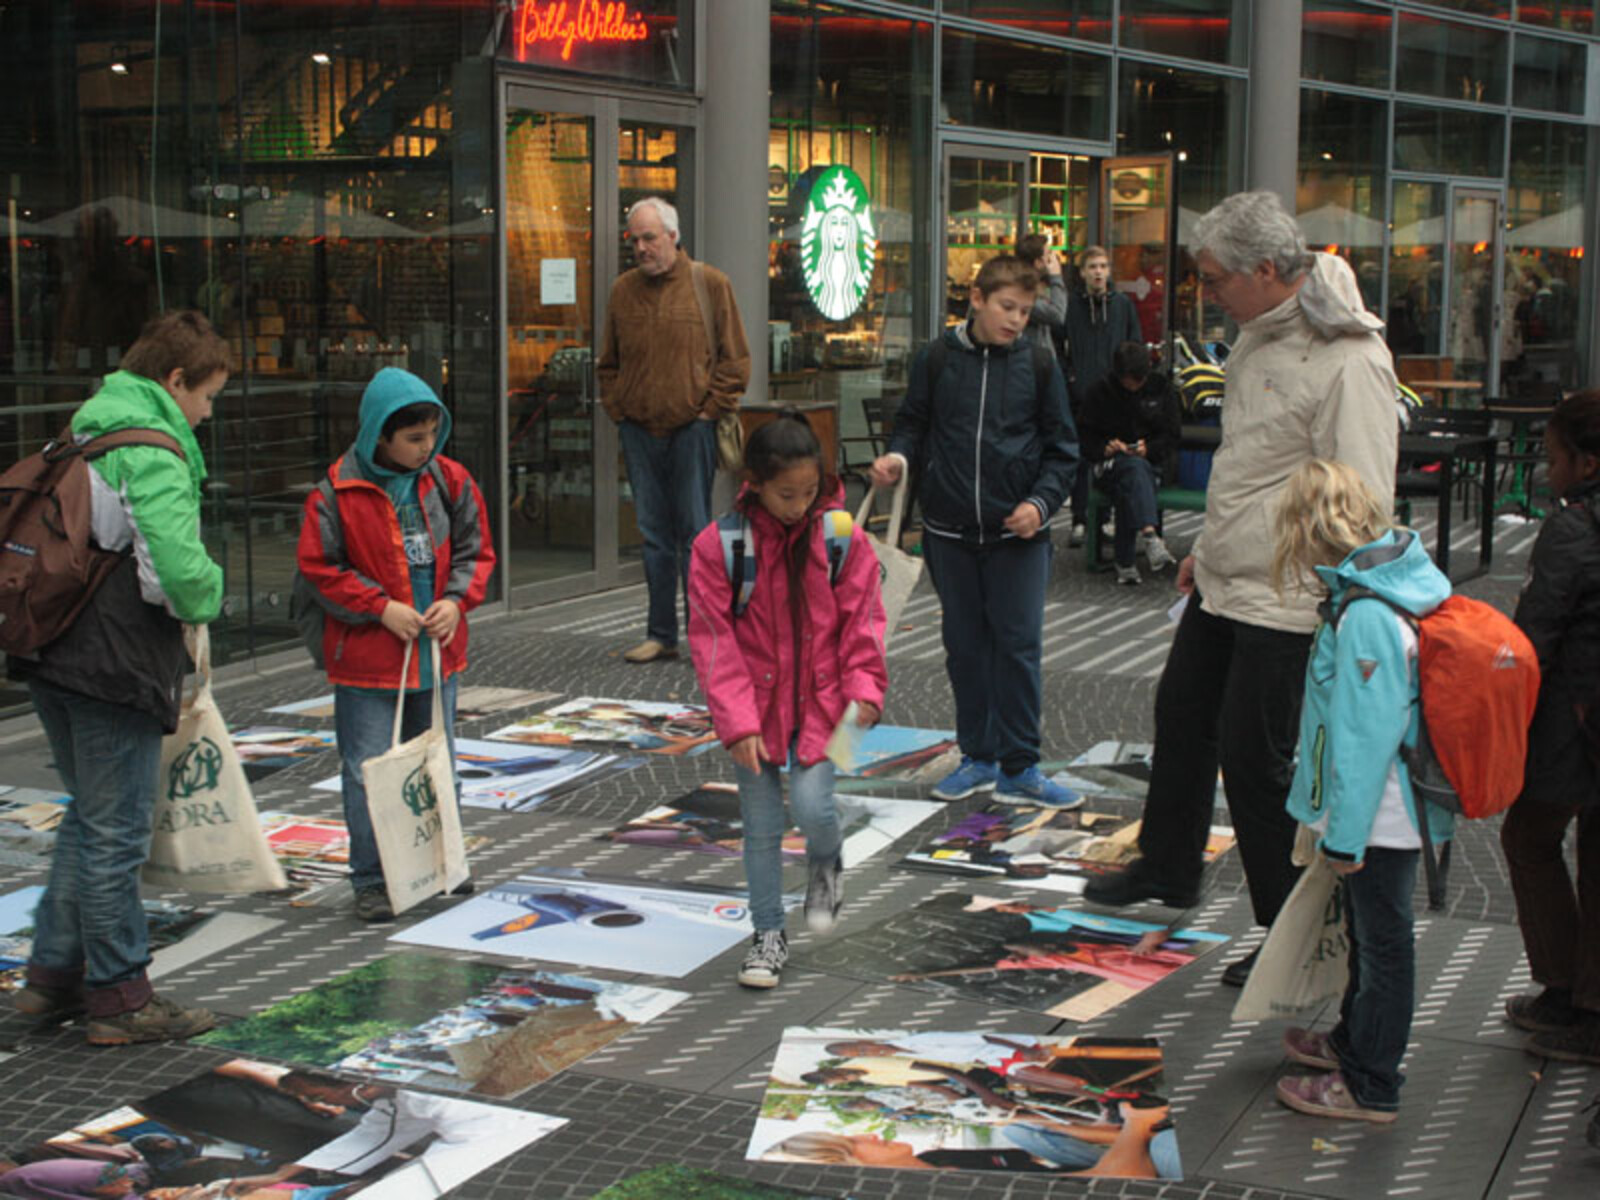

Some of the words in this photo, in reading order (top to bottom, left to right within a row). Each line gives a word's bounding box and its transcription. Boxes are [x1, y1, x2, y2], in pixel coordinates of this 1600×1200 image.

[518, 0, 577, 62] Billy
[578, 0, 648, 42] Wilder's
[157, 800, 231, 832] ADRA
